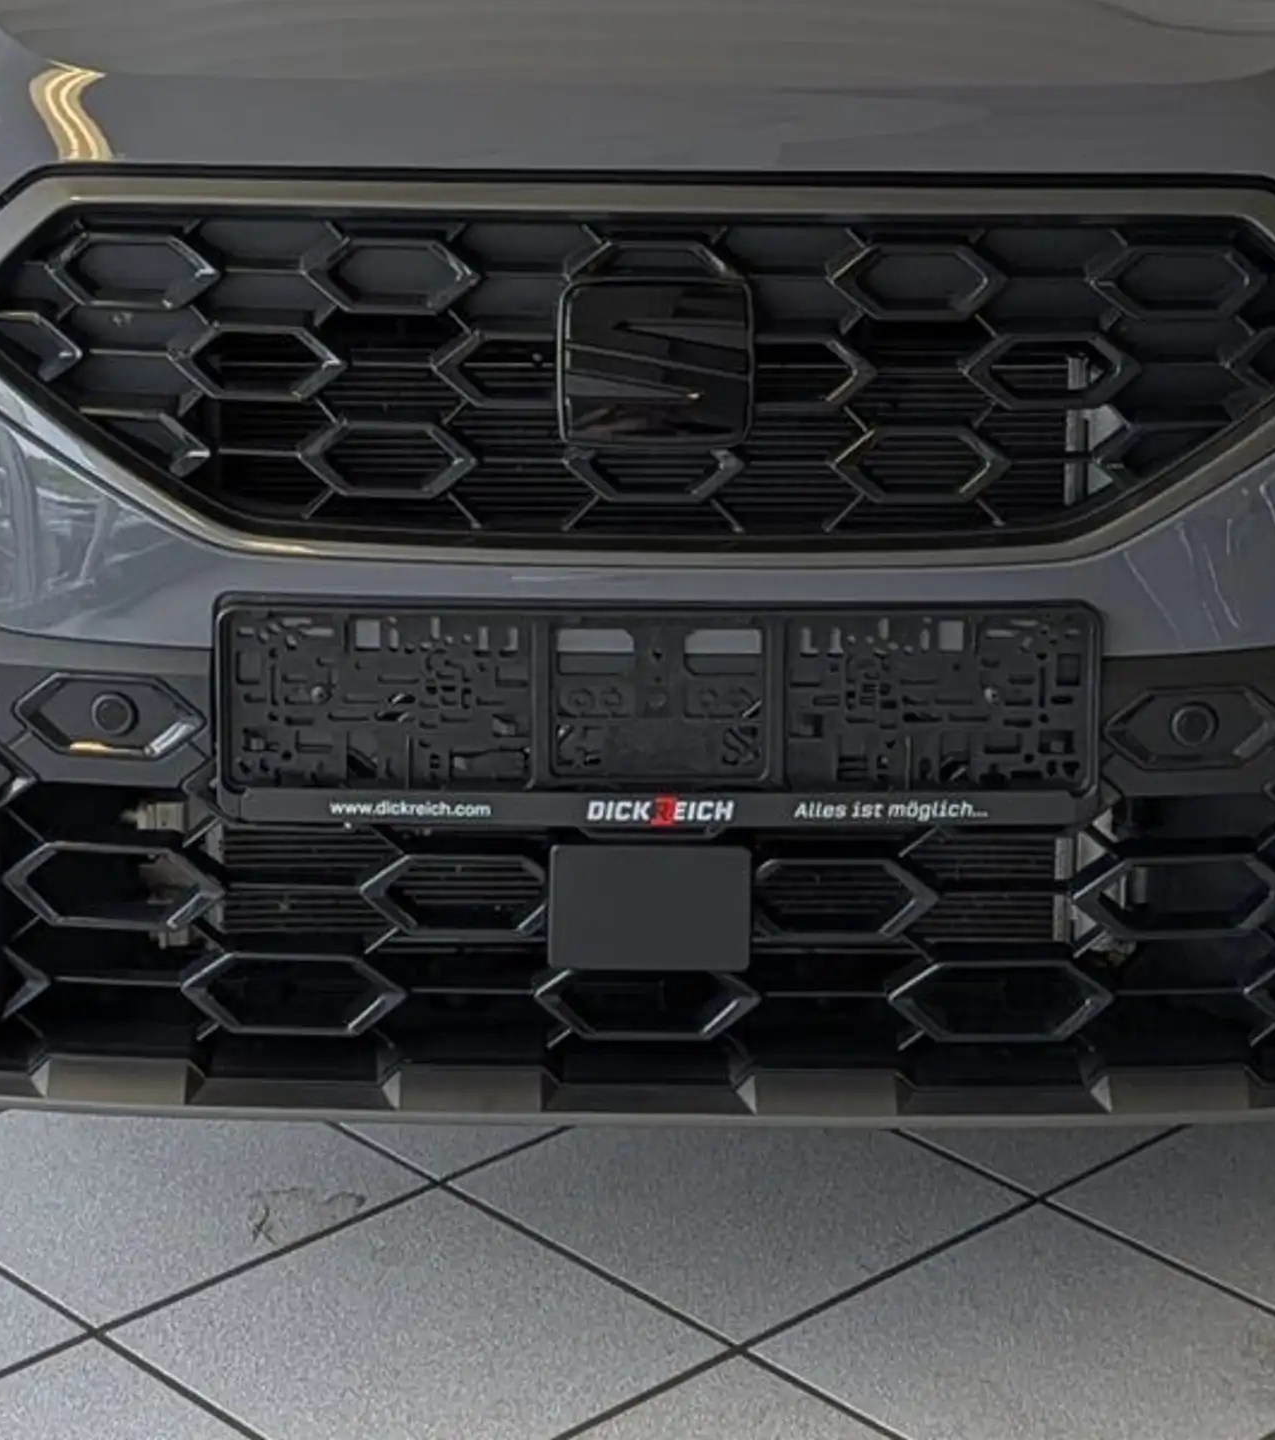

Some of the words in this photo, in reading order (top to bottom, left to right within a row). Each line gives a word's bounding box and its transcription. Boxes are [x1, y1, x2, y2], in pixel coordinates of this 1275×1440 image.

[329, 800, 491, 817] www.dickreich.com
[586, 797, 734, 826] DICKREICH
[794, 801, 847, 819] Alles
[851, 800, 884, 818] ist
